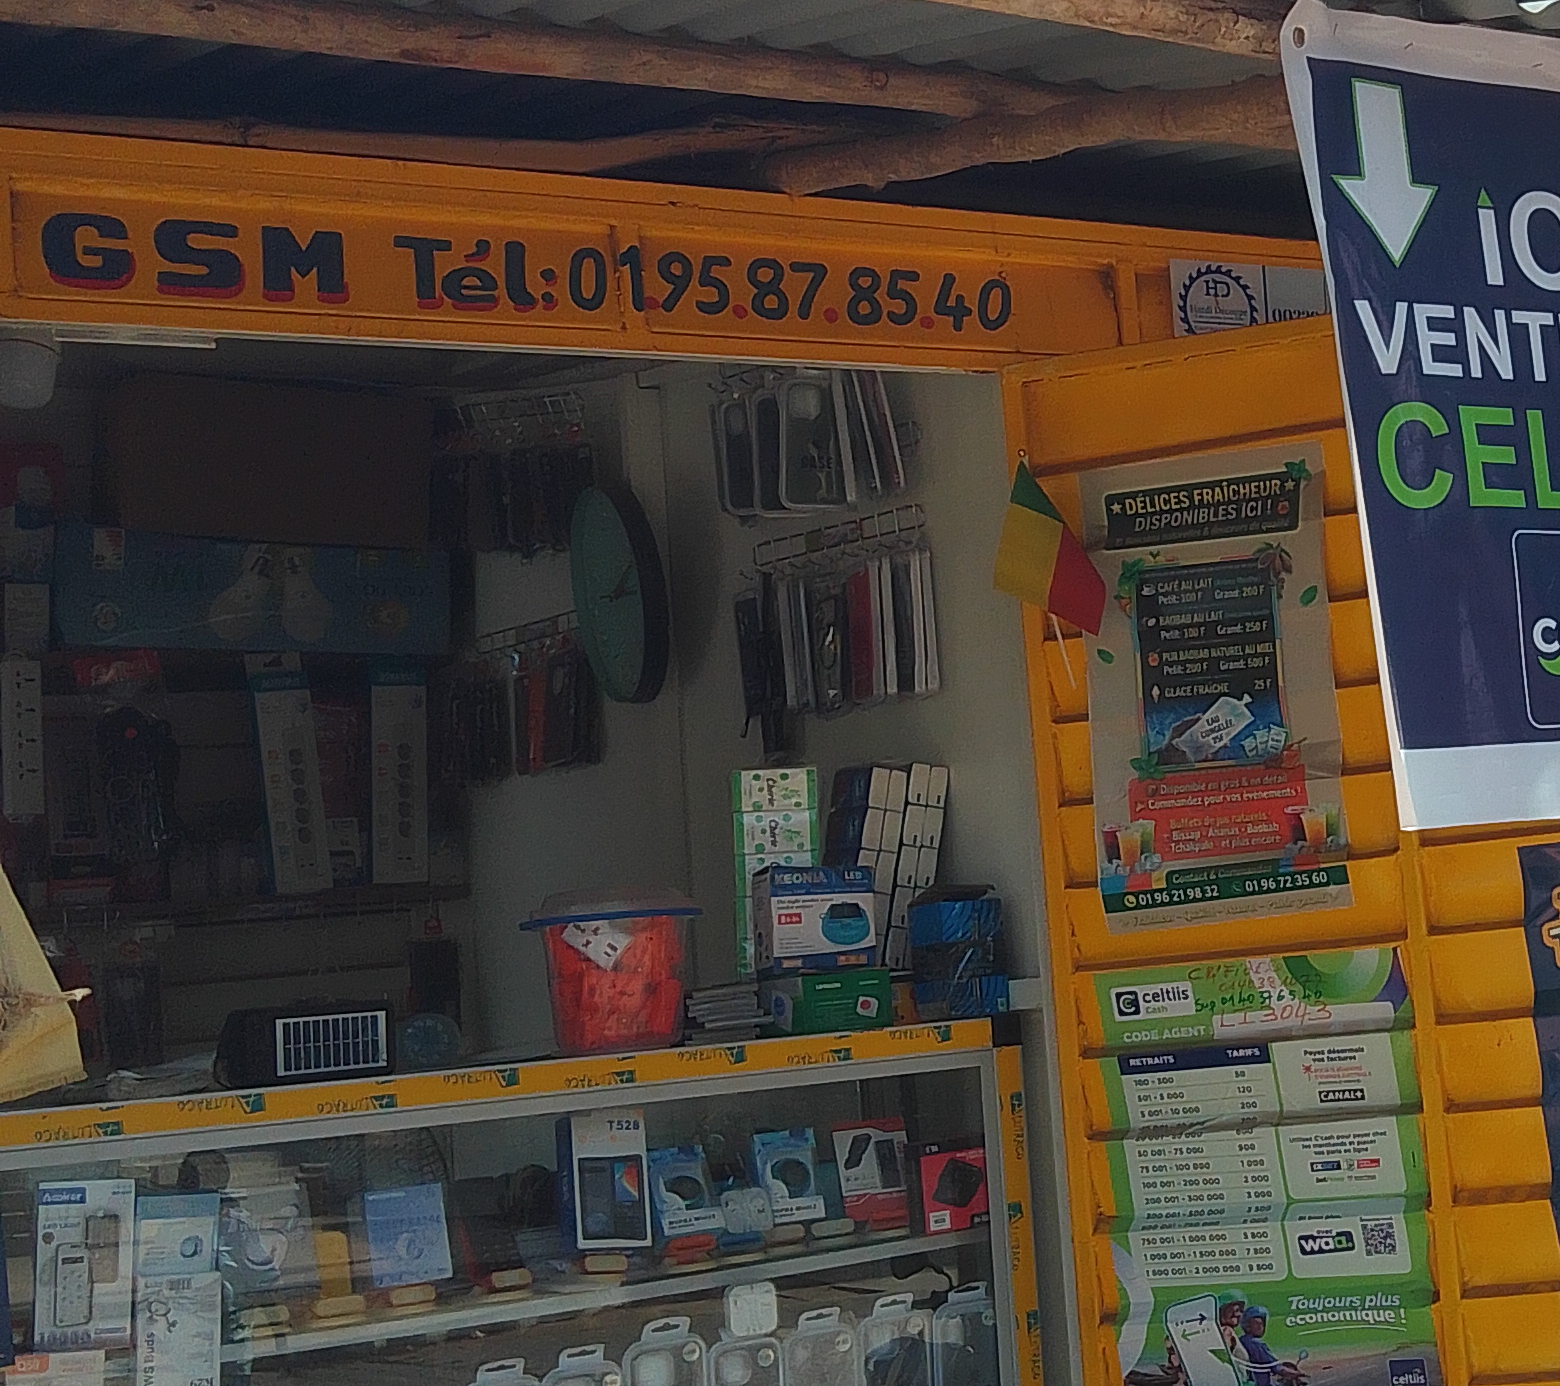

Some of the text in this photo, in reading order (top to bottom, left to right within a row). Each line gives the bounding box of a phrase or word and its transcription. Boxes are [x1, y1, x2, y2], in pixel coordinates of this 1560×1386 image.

[41, 212, 350, 304] GSM
[1124, 477, 1282, 516] DÉLICES FRAÎCHEUR
[1135, 501, 1263, 532] DISPONIBLES ICI
[1139, 871, 1328, 906] 01 96 21 98 32 01 96 72 35 60
[1123, 1025, 1206, 1043] CODE AGENT
[1320, 1090, 1363, 1102] CANAL+
[1288, 1292, 1401, 1312] Toujours plus
[1286, 1305, 1397, 1328] économique
